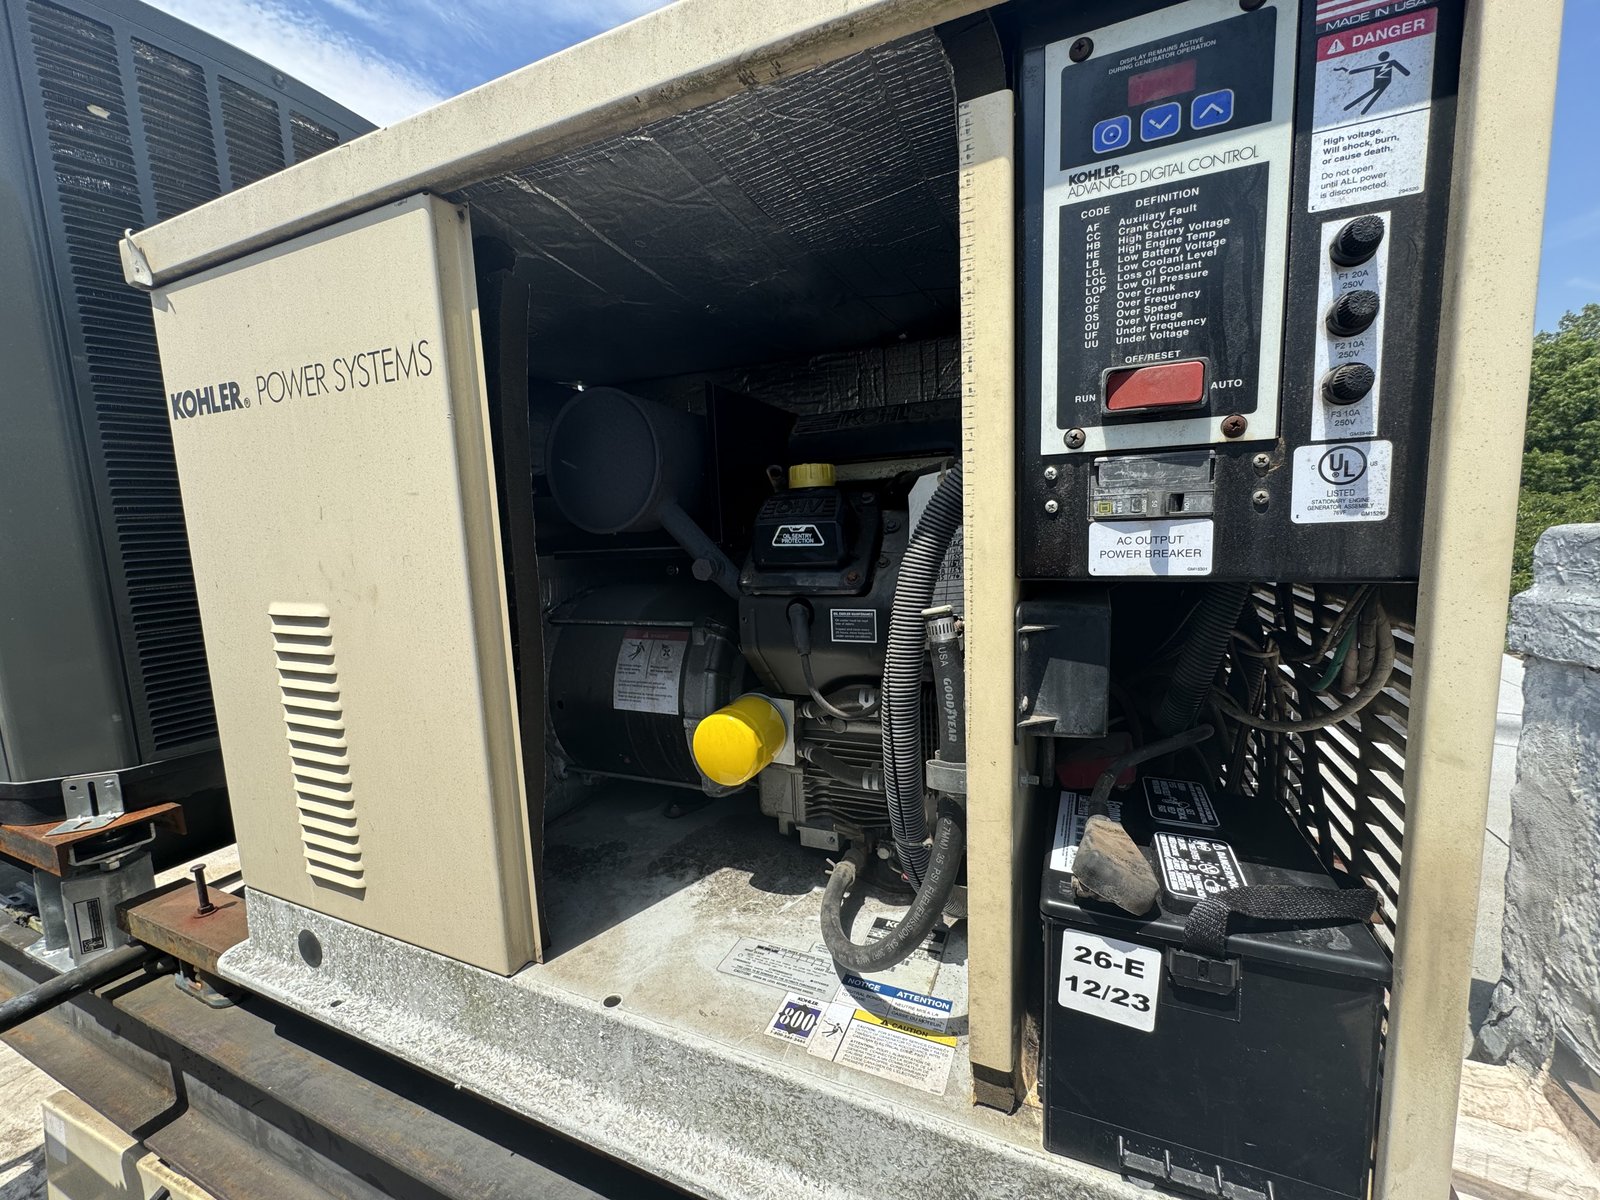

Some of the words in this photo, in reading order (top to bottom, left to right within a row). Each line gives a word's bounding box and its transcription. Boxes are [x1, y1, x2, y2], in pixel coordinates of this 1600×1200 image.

[1325, 11, 1371, 31] MADE
[1374, 6, 1389, 18] IN
[1394, 0, 1427, 12] USA
[1352, 18, 1425, 48] DANGER
[1108, 63, 1134, 75] DURING
[1134, 51, 1176, 70] GENERATOR
[1176, 39, 1217, 56] OPERATION
[1119, 53, 1147, 66] DISPLAY
[1147, 44, 1179, 57] REMAINS
[1179, 37, 1204, 51] ACTIVE
[1322, 146, 1340, 155] Will
[1342, 139, 1373, 151] shock,
[1323, 135, 1345, 146] High
[1347, 128, 1385, 141] voltage.
[1334, 152, 1362, 163] cause
[1364, 145, 1393, 157] death.
[1068, 171, 1137, 199] ADVANCED
[1140, 161, 1185, 183] DIGITAL
[1188, 145, 1259, 171] CONTROL
[1320, 181, 1338, 190] until
[1340, 176, 1358, 187] ALL
[1360, 171, 1388, 183] power
[1321, 172, 1334, 181] Do
[1335, 168, 1350, 179] not
[1351, 164, 1374, 176] open
[1329, 180, 1389, 197] disconnected.
[1080, 205, 1111, 219] CODE
[1135, 187, 1200, 208] DEFINITION
[1086, 222, 1100, 233] AF
[1118, 211, 1165, 227] Auxiliary
[1169, 204, 1198, 215] Fault
[1086, 232, 1101, 242] CC
[1118, 222, 1149, 236] Crank
[1152, 217, 1183, 230] Cycle
[1086, 241, 1101, 251] HB
[1118, 235, 1142, 246] High
[1145, 226, 1184, 240] Battery
[1188, 217, 1231, 232] Voltage
[1086, 250, 1100, 260] HE
[1118, 244, 1142, 255] High
[1145, 236, 1183, 250] Engine
[1186, 231, 1217, 242] Temp
[1086, 259, 1099, 269] LB
[1117, 254, 1139, 263] Low
[1142, 245, 1181, 259] Battery
[1185, 238, 1227, 252] Voltage
[1085, 268, 1106, 278] LCL
[1117, 263, 1138, 273] Low
[1141, 255, 1184, 268] Coolant
[1187, 248, 1217, 260] Level
[1085, 276, 1107, 287] LOC
[1117, 272, 1142, 282] Loss
[1145, 267, 1156, 275] of
[1159, 261, 1202, 274] Coolant
[1085, 285, 1106, 296] LOP
[1117, 280, 1138, 291] Low
[1141, 276, 1156, 286] Oil
[1159, 269, 1209, 284] Pressure
[1342, 280, 1364, 289] 250V
[1351, 269, 1369, 279] 20A
[1085, 295, 1101, 305] OC
[1117, 290, 1141, 300] Over
[1144, 283, 1176, 295] Crank
[1085, 304, 1099, 314] OF
[1116, 298, 1141, 309] Over
[1144, 289, 1201, 305] Frequency
[1084, 313, 1099, 323] OS
[1116, 308, 1140, 318] Over
[1144, 302, 1177, 315] Speed
[1084, 322, 1100, 331] OU
[1116, 317, 1140, 327] Over
[1144, 310, 1184, 323] Voltage
[1084, 331, 1098, 340] UF
[1116, 325, 1147, 336] Under
[1150, 317, 1207, 331] Frequency
[1084, 340, 1099, 349] UU
[1116, 334, 1147, 345] Under
[1150, 328, 1190, 341] Voltage
[1335, 342, 1345, 350] F2
[1348, 340, 1365, 349] 10A
[1338, 350, 1360, 359] 250V
[1125, 350, 1182, 364] OFF/RESET
[256, 363, 329, 405] POWER
[332, 339, 433, 392] SYSTEMS
[1210, 378, 1243, 390] AUTO
[1075, 394, 1096, 404] RUN
[1331, 410, 1342, 418] F3
[1343, 409, 1360, 418] 10A
[1334, 419, 1356, 427] 250V
[1329, 453, 1356, 478] UL
[1326, 488, 1356, 498] LISTED
[1116, 536, 1132, 545] AC
[1135, 535, 1184, 545] OUTPUT
[1099, 549, 1142, 559] POWER
[1145, 548, 1202, 558] BREAKER
[937, 647, 949, 667] USA
[943, 677, 957, 743] GOODYEAR
[935, 852, 945, 865] 35
[930, 867, 942, 884] PSI
[898, 885, 935, 942] FUEL/EMISSION
[886, 938, 899, 953] SAE
[1073, 945, 1145, 979] 26-E
[847, 977, 881, 992] NOTICE
[1064, 974, 1151, 1012] 12/23
[797, 997, 819, 1006] KOHLER
[896, 991, 950, 1010] ATTENTION
[780, 1007, 816, 1031] 800
[892, 1022, 929, 1037] CAUTION
